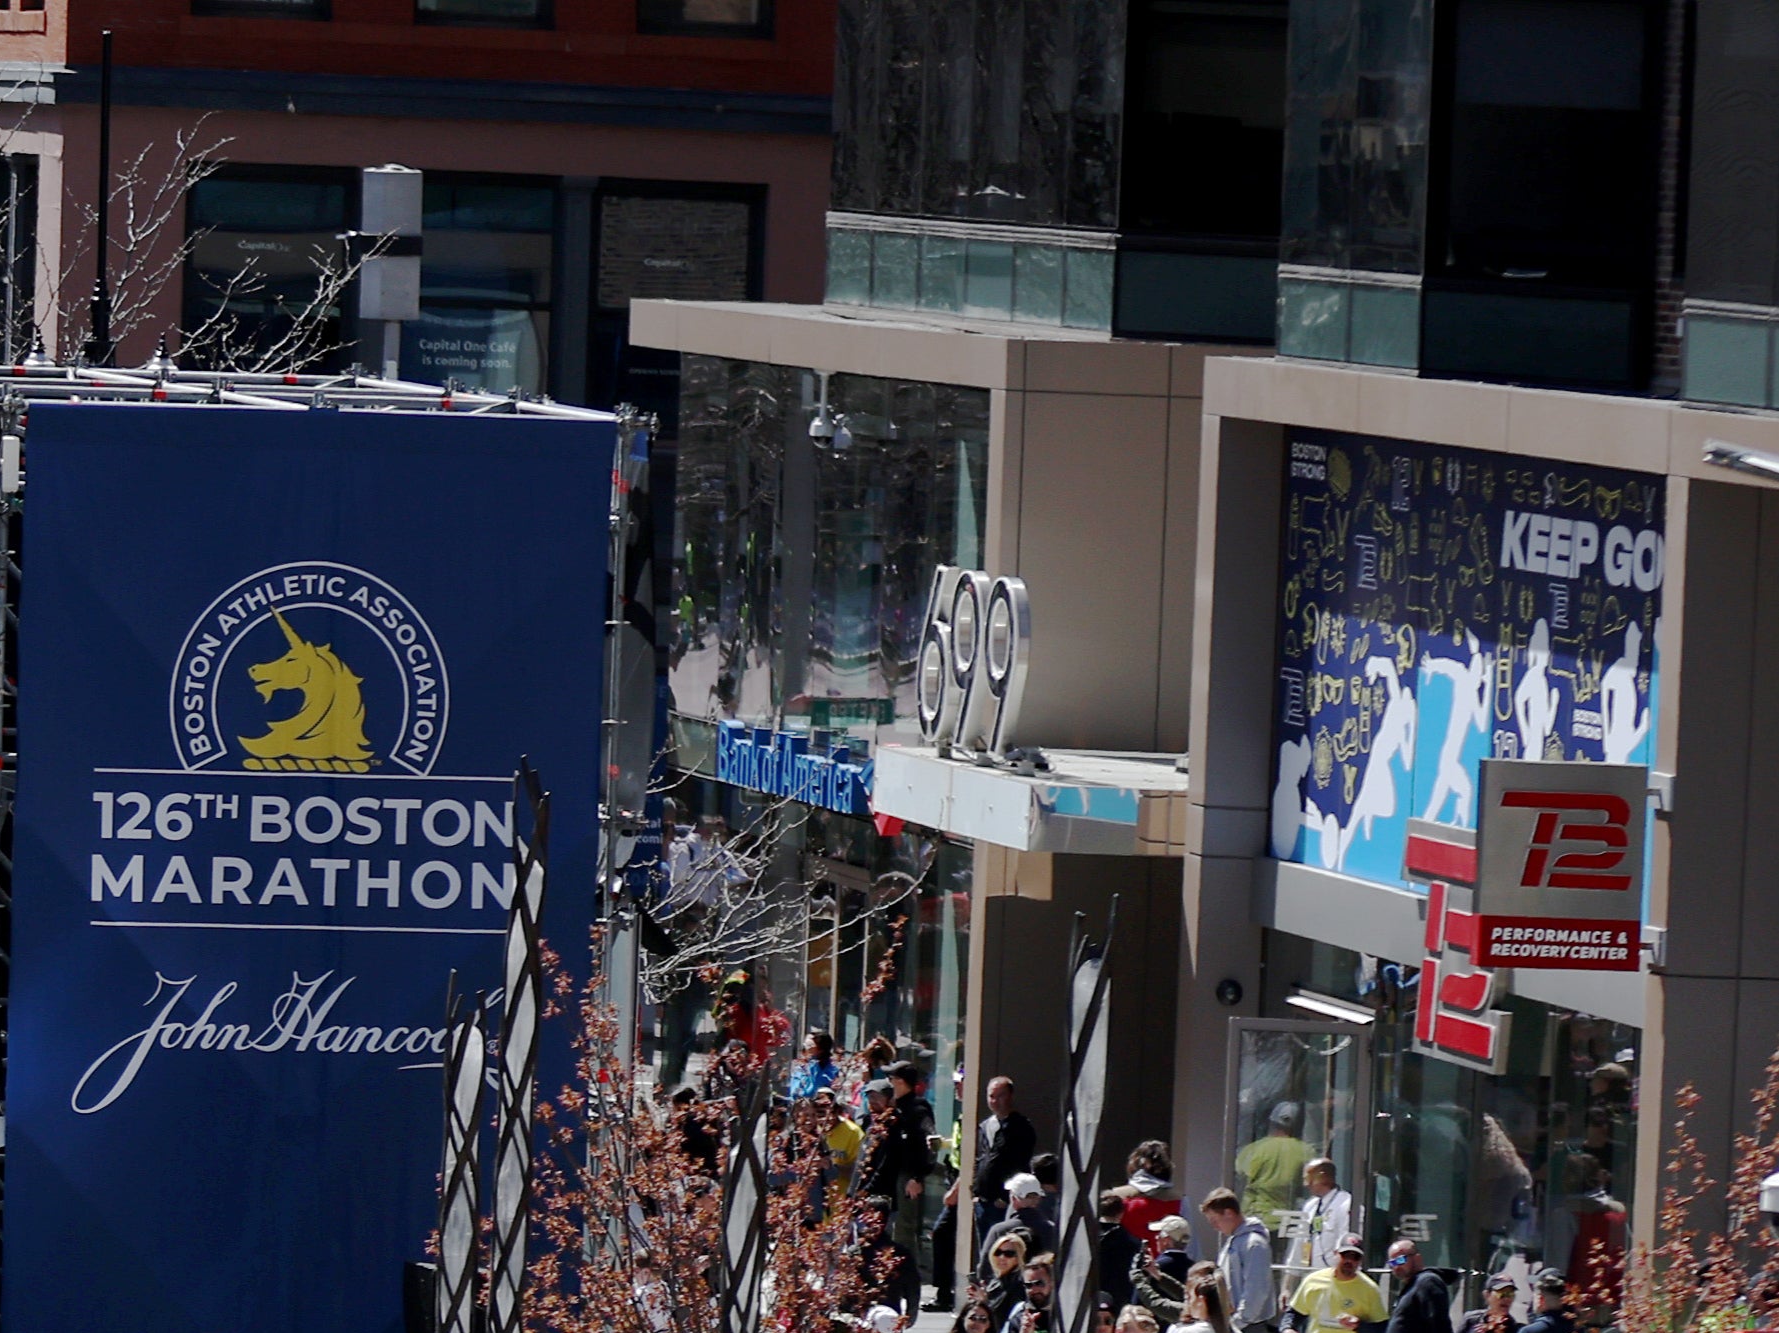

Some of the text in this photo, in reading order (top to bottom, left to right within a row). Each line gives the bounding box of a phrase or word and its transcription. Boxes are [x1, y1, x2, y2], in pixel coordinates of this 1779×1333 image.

[419, 338, 460, 354] Capital
[463, 339, 487, 353] One
[422, 355, 432, 366] is
[435, 355, 477, 370] coming
[1500, 510, 1599, 580] KEEP
[184, 573, 437, 763] BOSTON ATHLETIC ASSOCIATION
[917, 565, 1031, 760] 699
[716, 724, 853, 814] Bank of America
[92, 790, 515, 848] 126TH BOSTON
[90, 853, 516, 911] MARATHON
[1490, 926, 1628, 945] PERFORMANCE &
[1490, 942, 1629, 960] RECOVERY CENTER
[71, 970, 250, 1114] John
